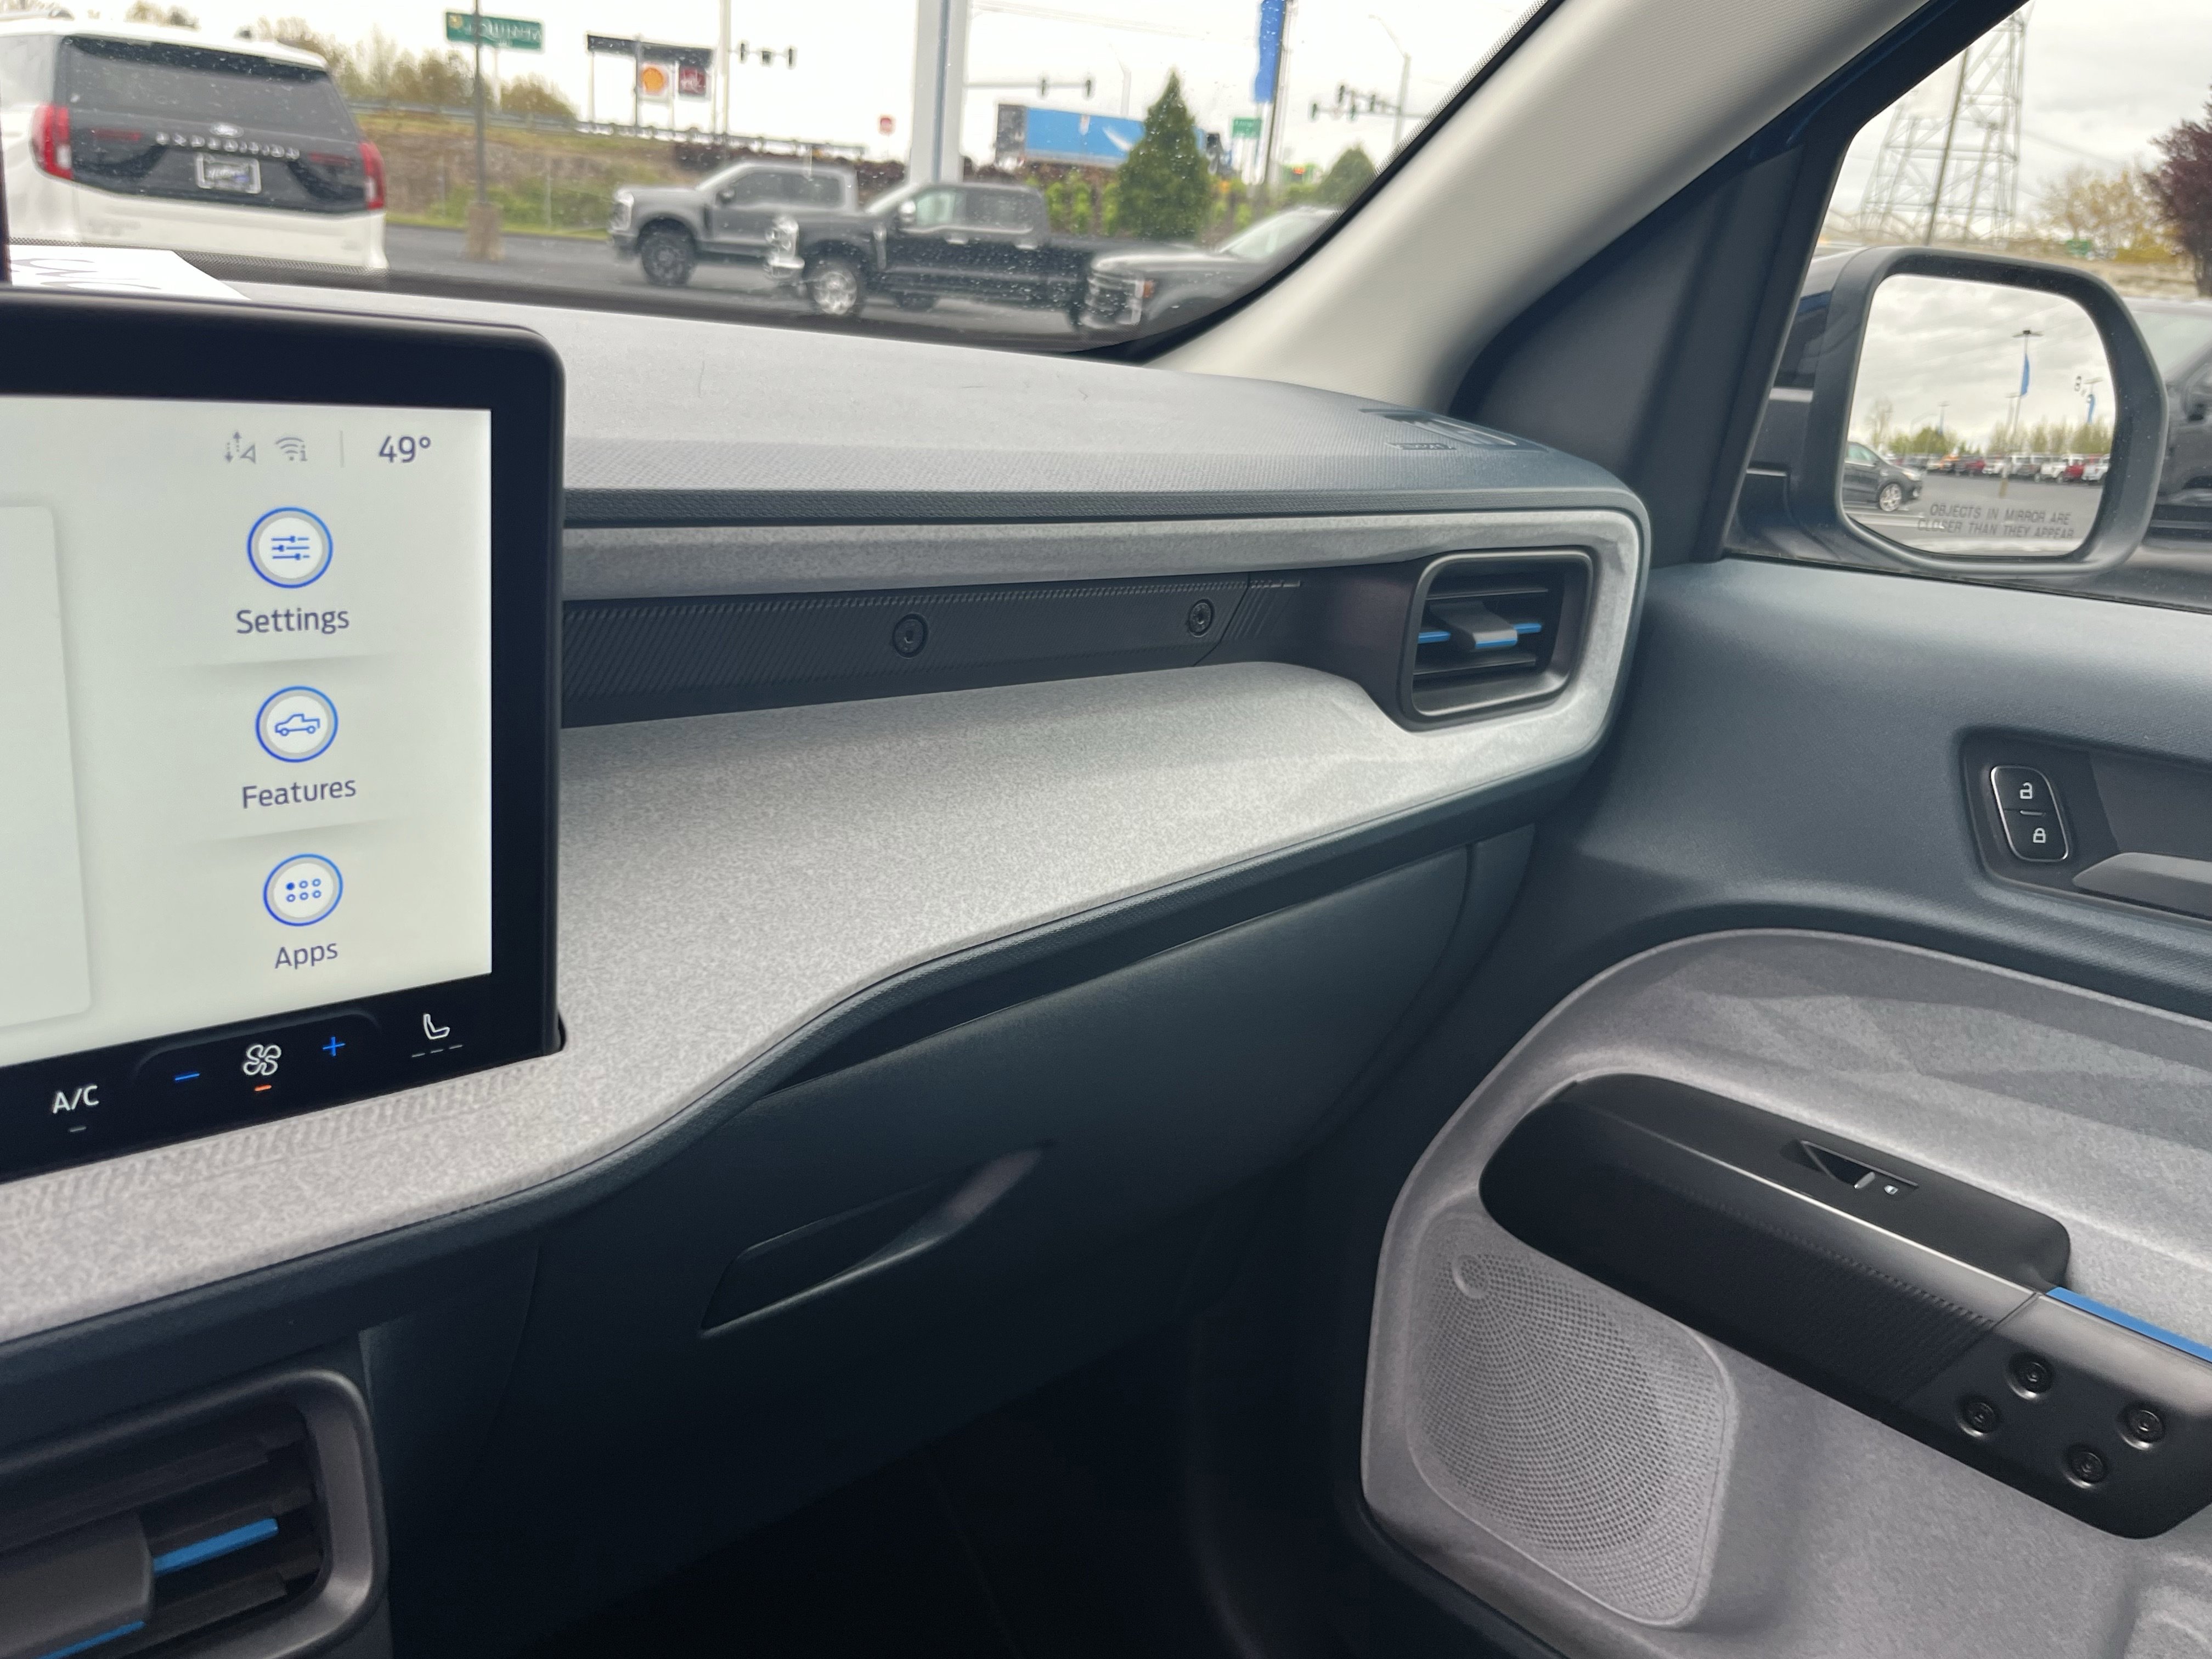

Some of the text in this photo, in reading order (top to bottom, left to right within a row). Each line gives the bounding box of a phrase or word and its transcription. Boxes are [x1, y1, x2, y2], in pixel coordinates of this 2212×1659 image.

[378, 435, 432, 464] 49°
[1930, 503, 2071, 525] OBJECTS IN MIRROR ARE
[1917, 518, 2074, 540] CLOSER THAN THEY APPEAR
[236, 607, 350, 635] Settings
[241, 779, 357, 809] Features
[274, 943, 338, 970] Apps
[52, 1085, 99, 1114] A/C
